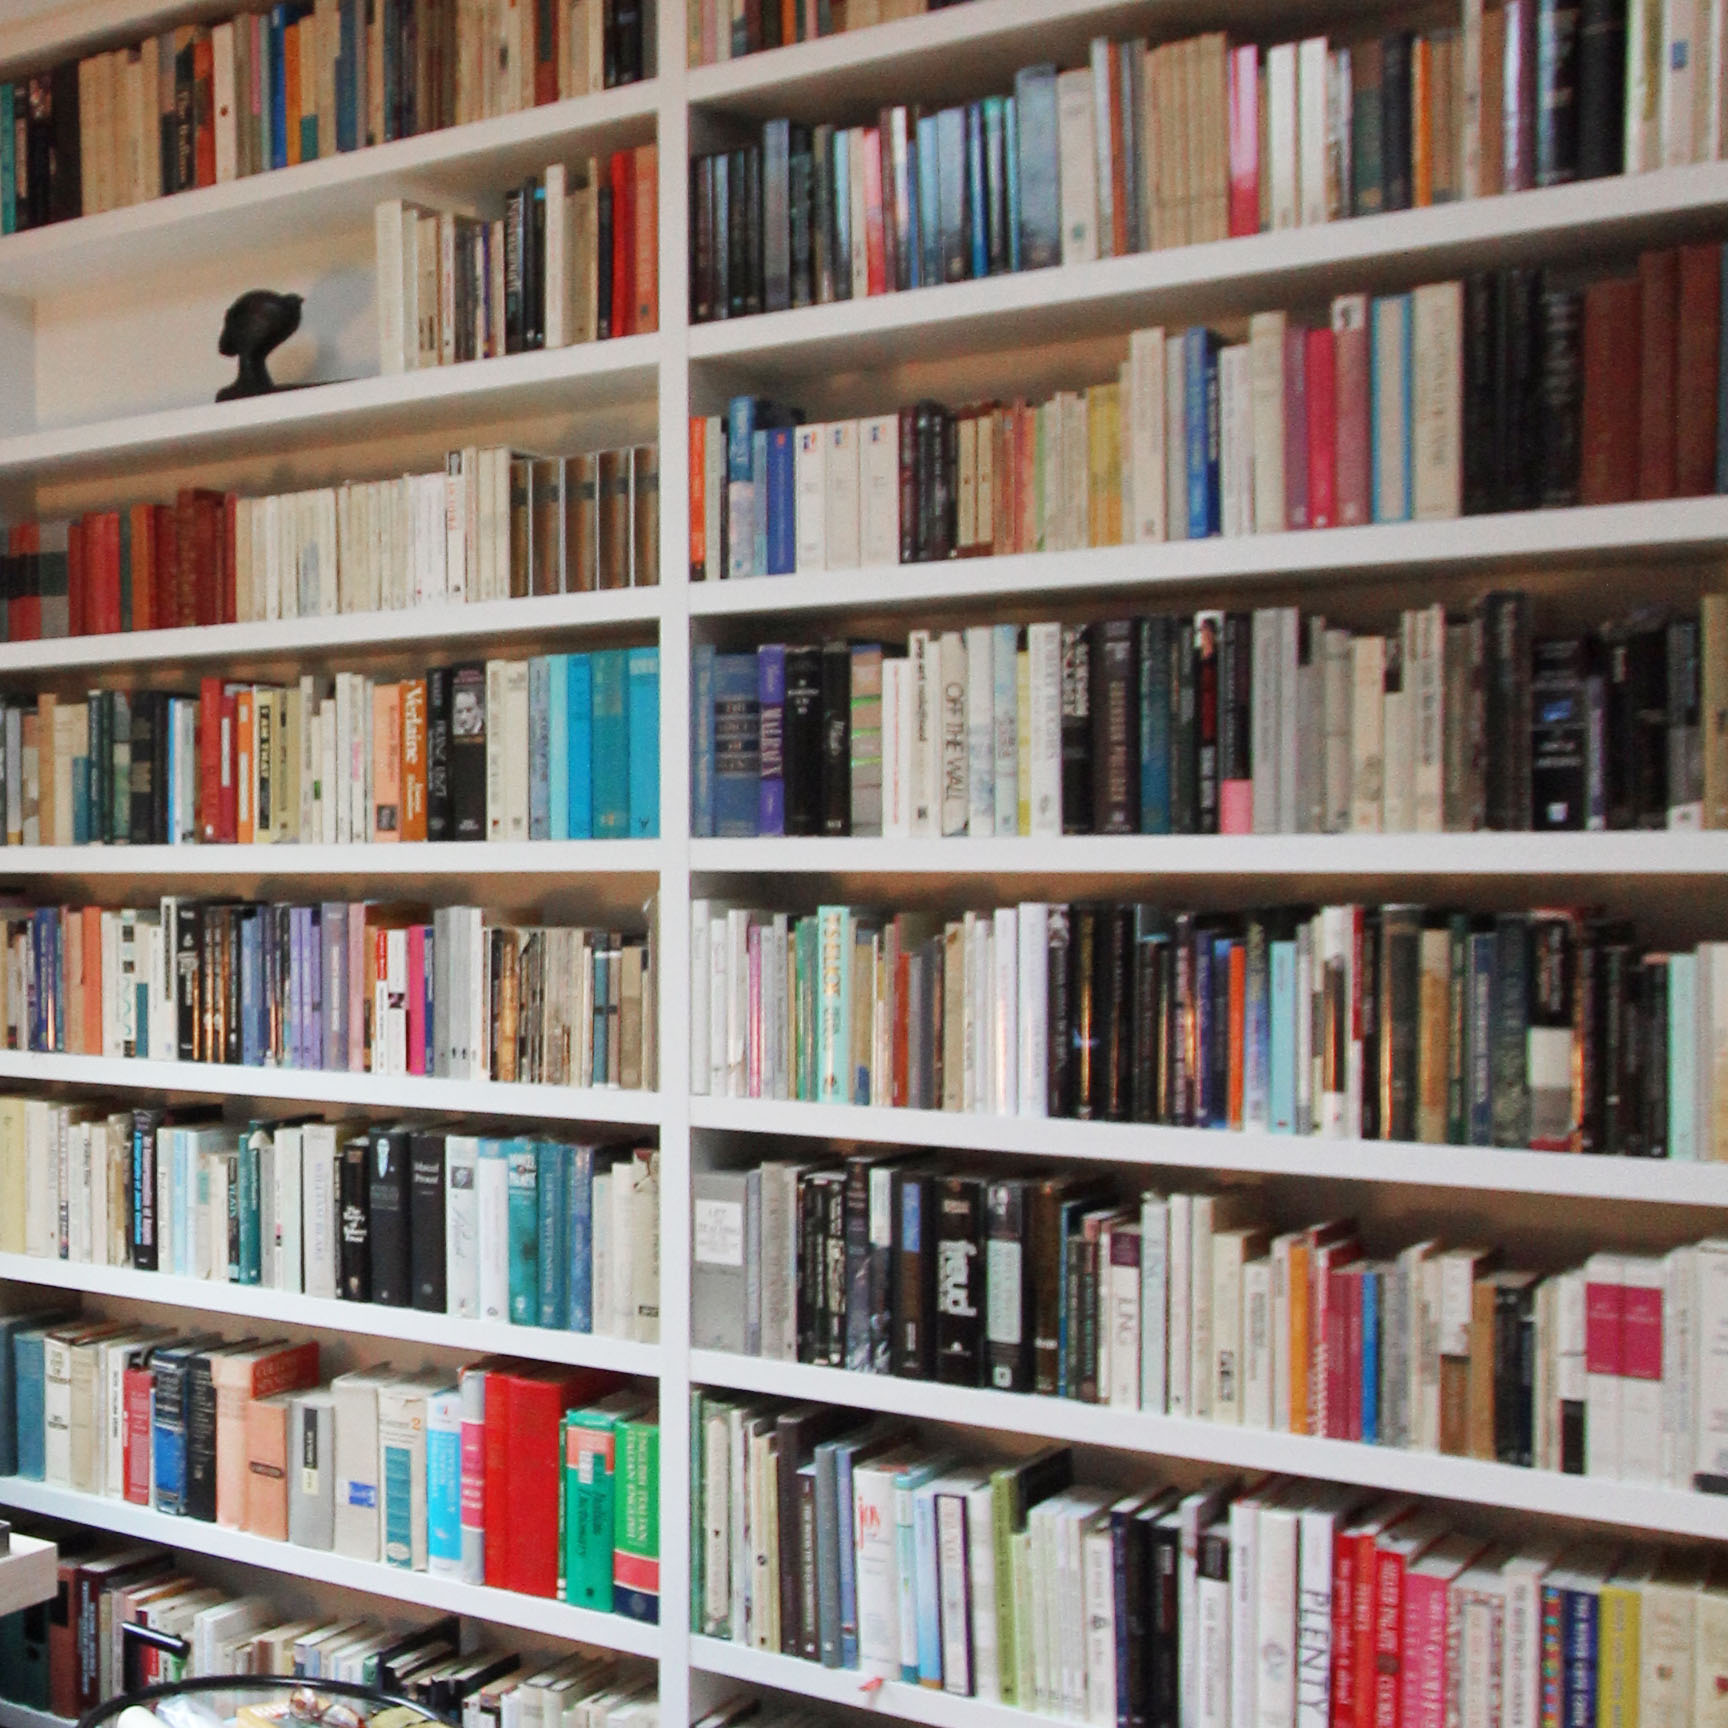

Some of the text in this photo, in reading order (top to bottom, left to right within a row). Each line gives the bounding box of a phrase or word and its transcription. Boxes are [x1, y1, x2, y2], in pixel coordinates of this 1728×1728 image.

[404, 687, 424, 764] Verlaine
[944, 682, 965, 802] OFF THE WALL
[259, 742, 269, 779] THAT
[625, 1429, 637, 1480] ITALIAN
[637, 1490, 649, 1542] ITALIAN
[1298, 1588, 1332, 1716] PLENTY
